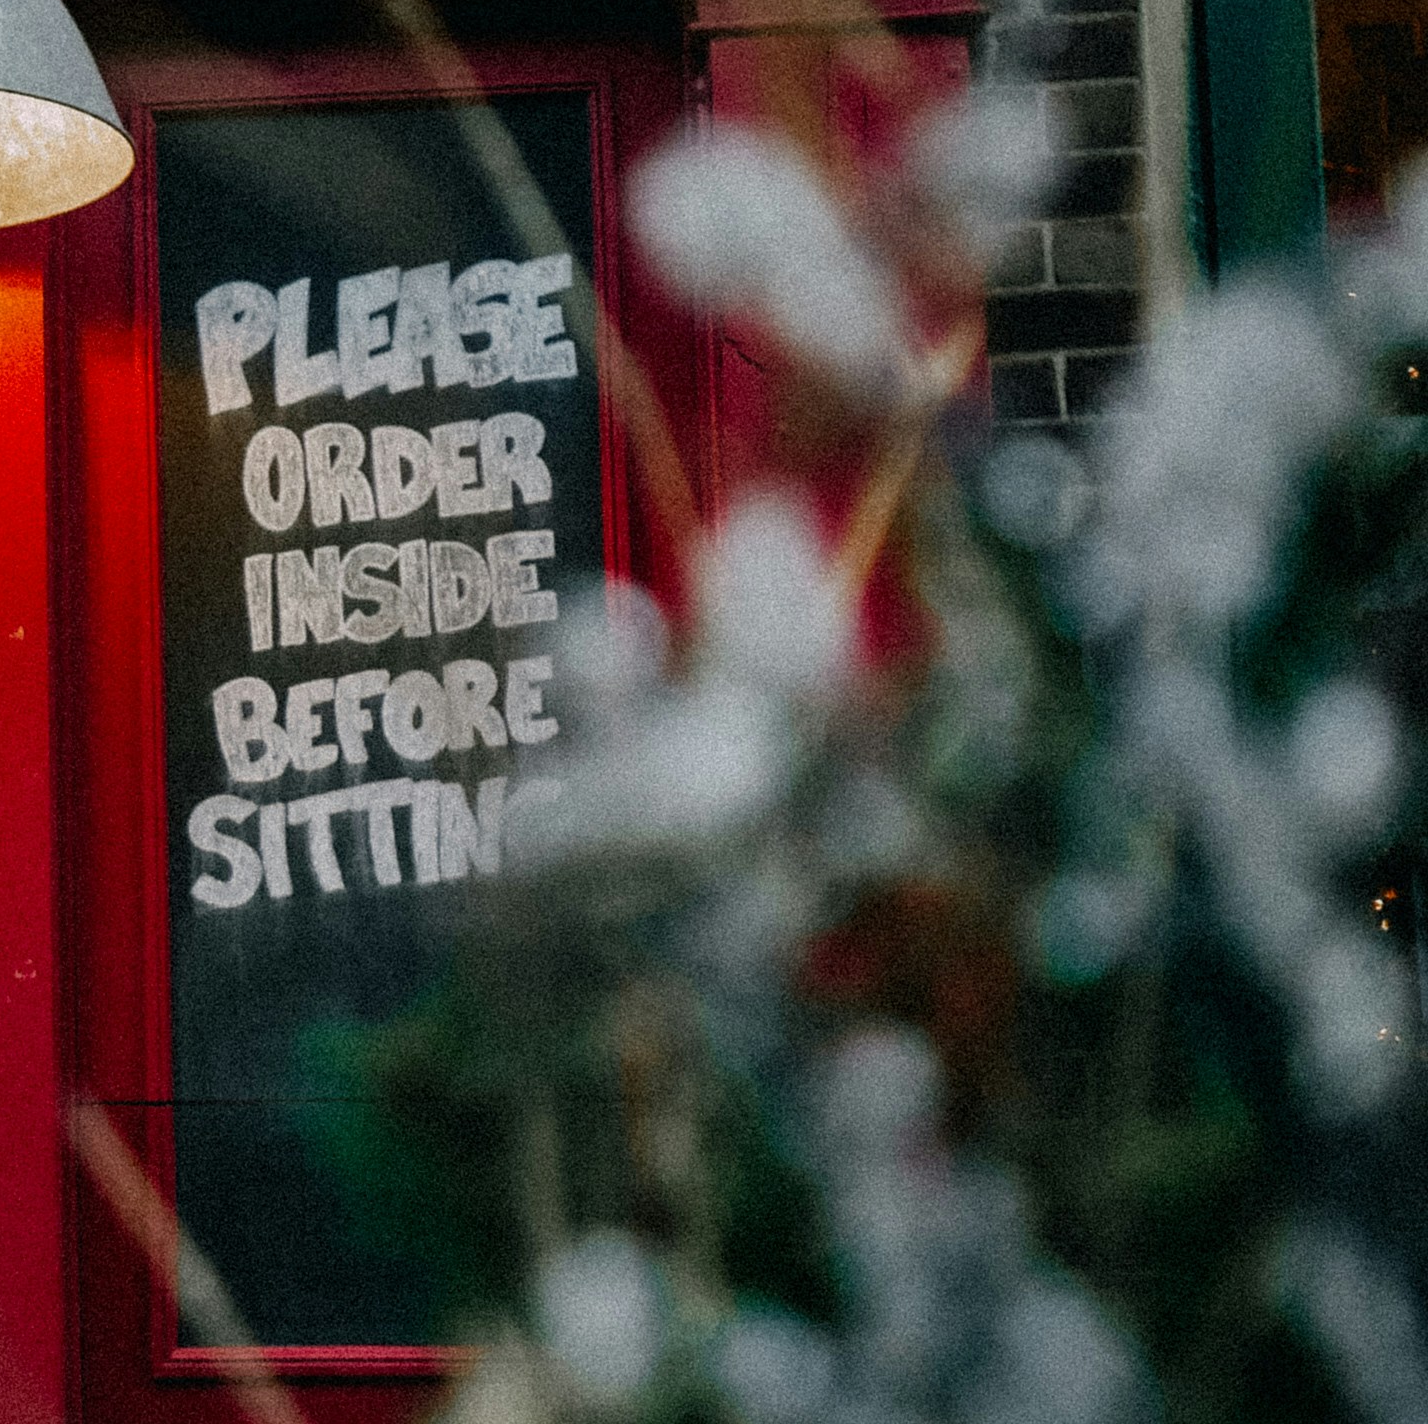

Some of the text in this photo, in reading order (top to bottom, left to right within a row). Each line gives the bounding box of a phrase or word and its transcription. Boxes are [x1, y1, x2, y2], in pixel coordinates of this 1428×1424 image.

[195, 252, 578, 416] PLEASE
[243, 411, 553, 532] ORDER
[243, 528, 559, 652] INSIDE
[212, 655, 560, 783] BEFORE
